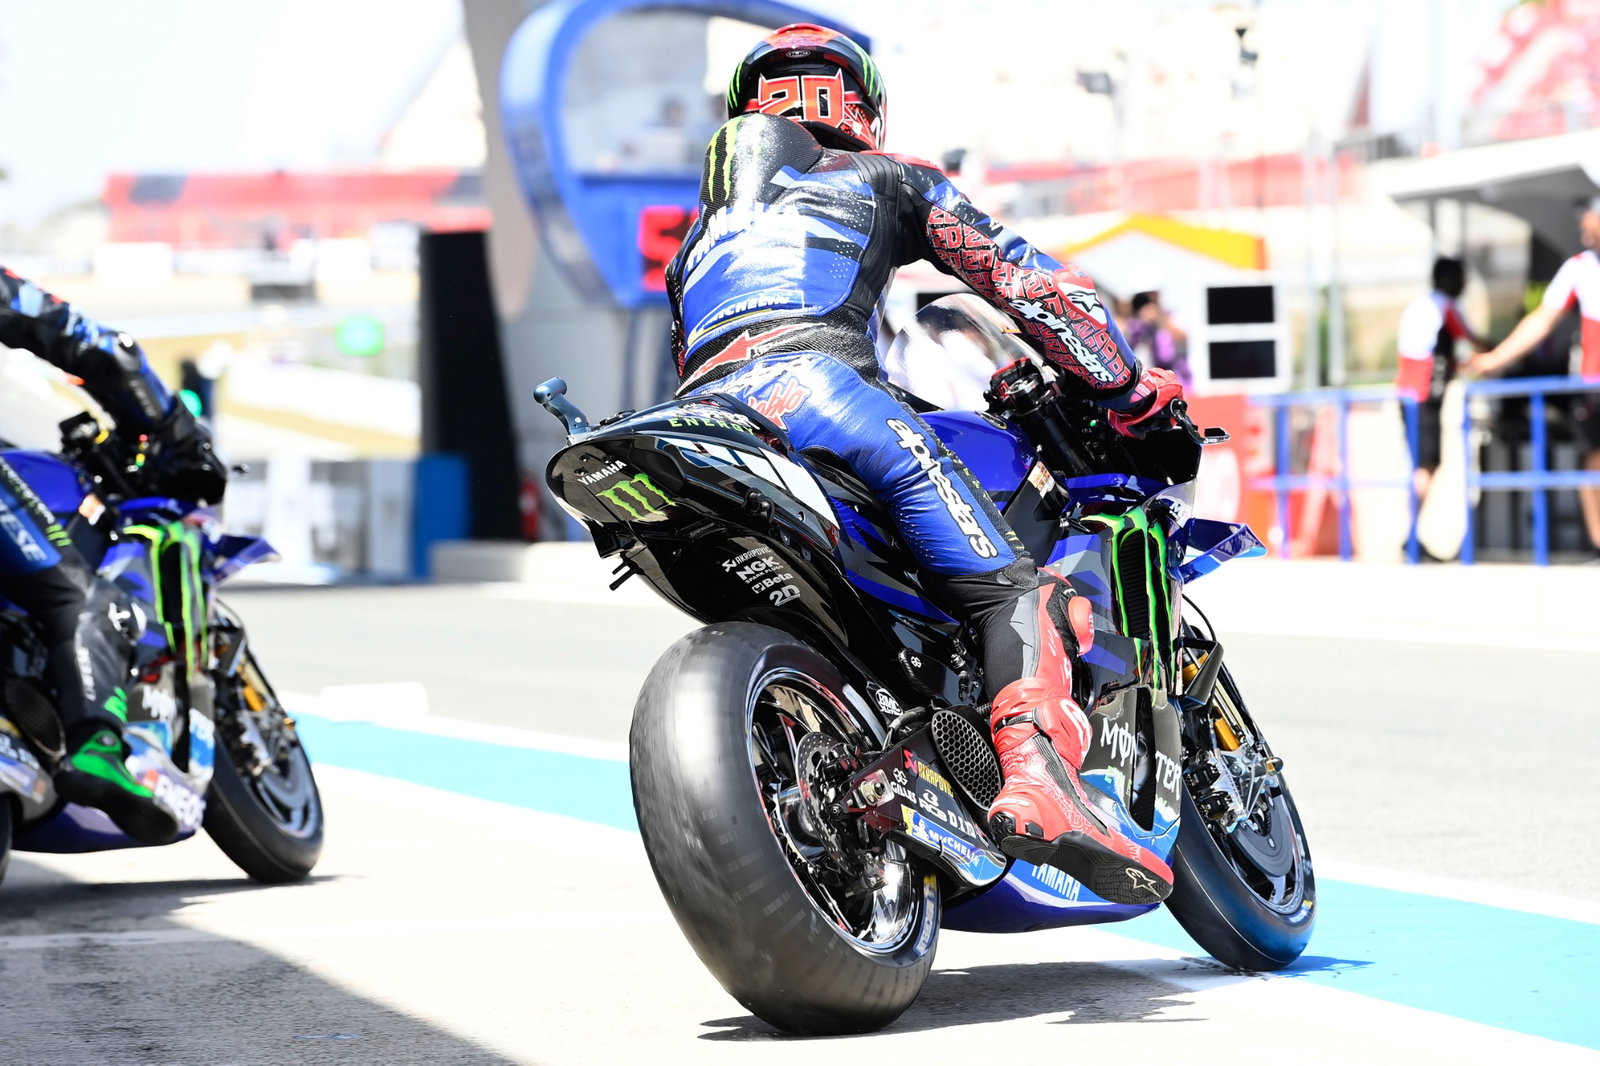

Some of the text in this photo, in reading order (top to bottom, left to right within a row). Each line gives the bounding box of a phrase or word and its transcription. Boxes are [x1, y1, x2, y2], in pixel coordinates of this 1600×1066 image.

[758, 67, 845, 128] 20
[962, 247, 996, 271] 20
[577, 460, 628, 485] YAMAHA
[736, 556, 780, 581] NGK
[762, 573, 794, 588] Beta
[891, 781, 917, 804] GILLES
